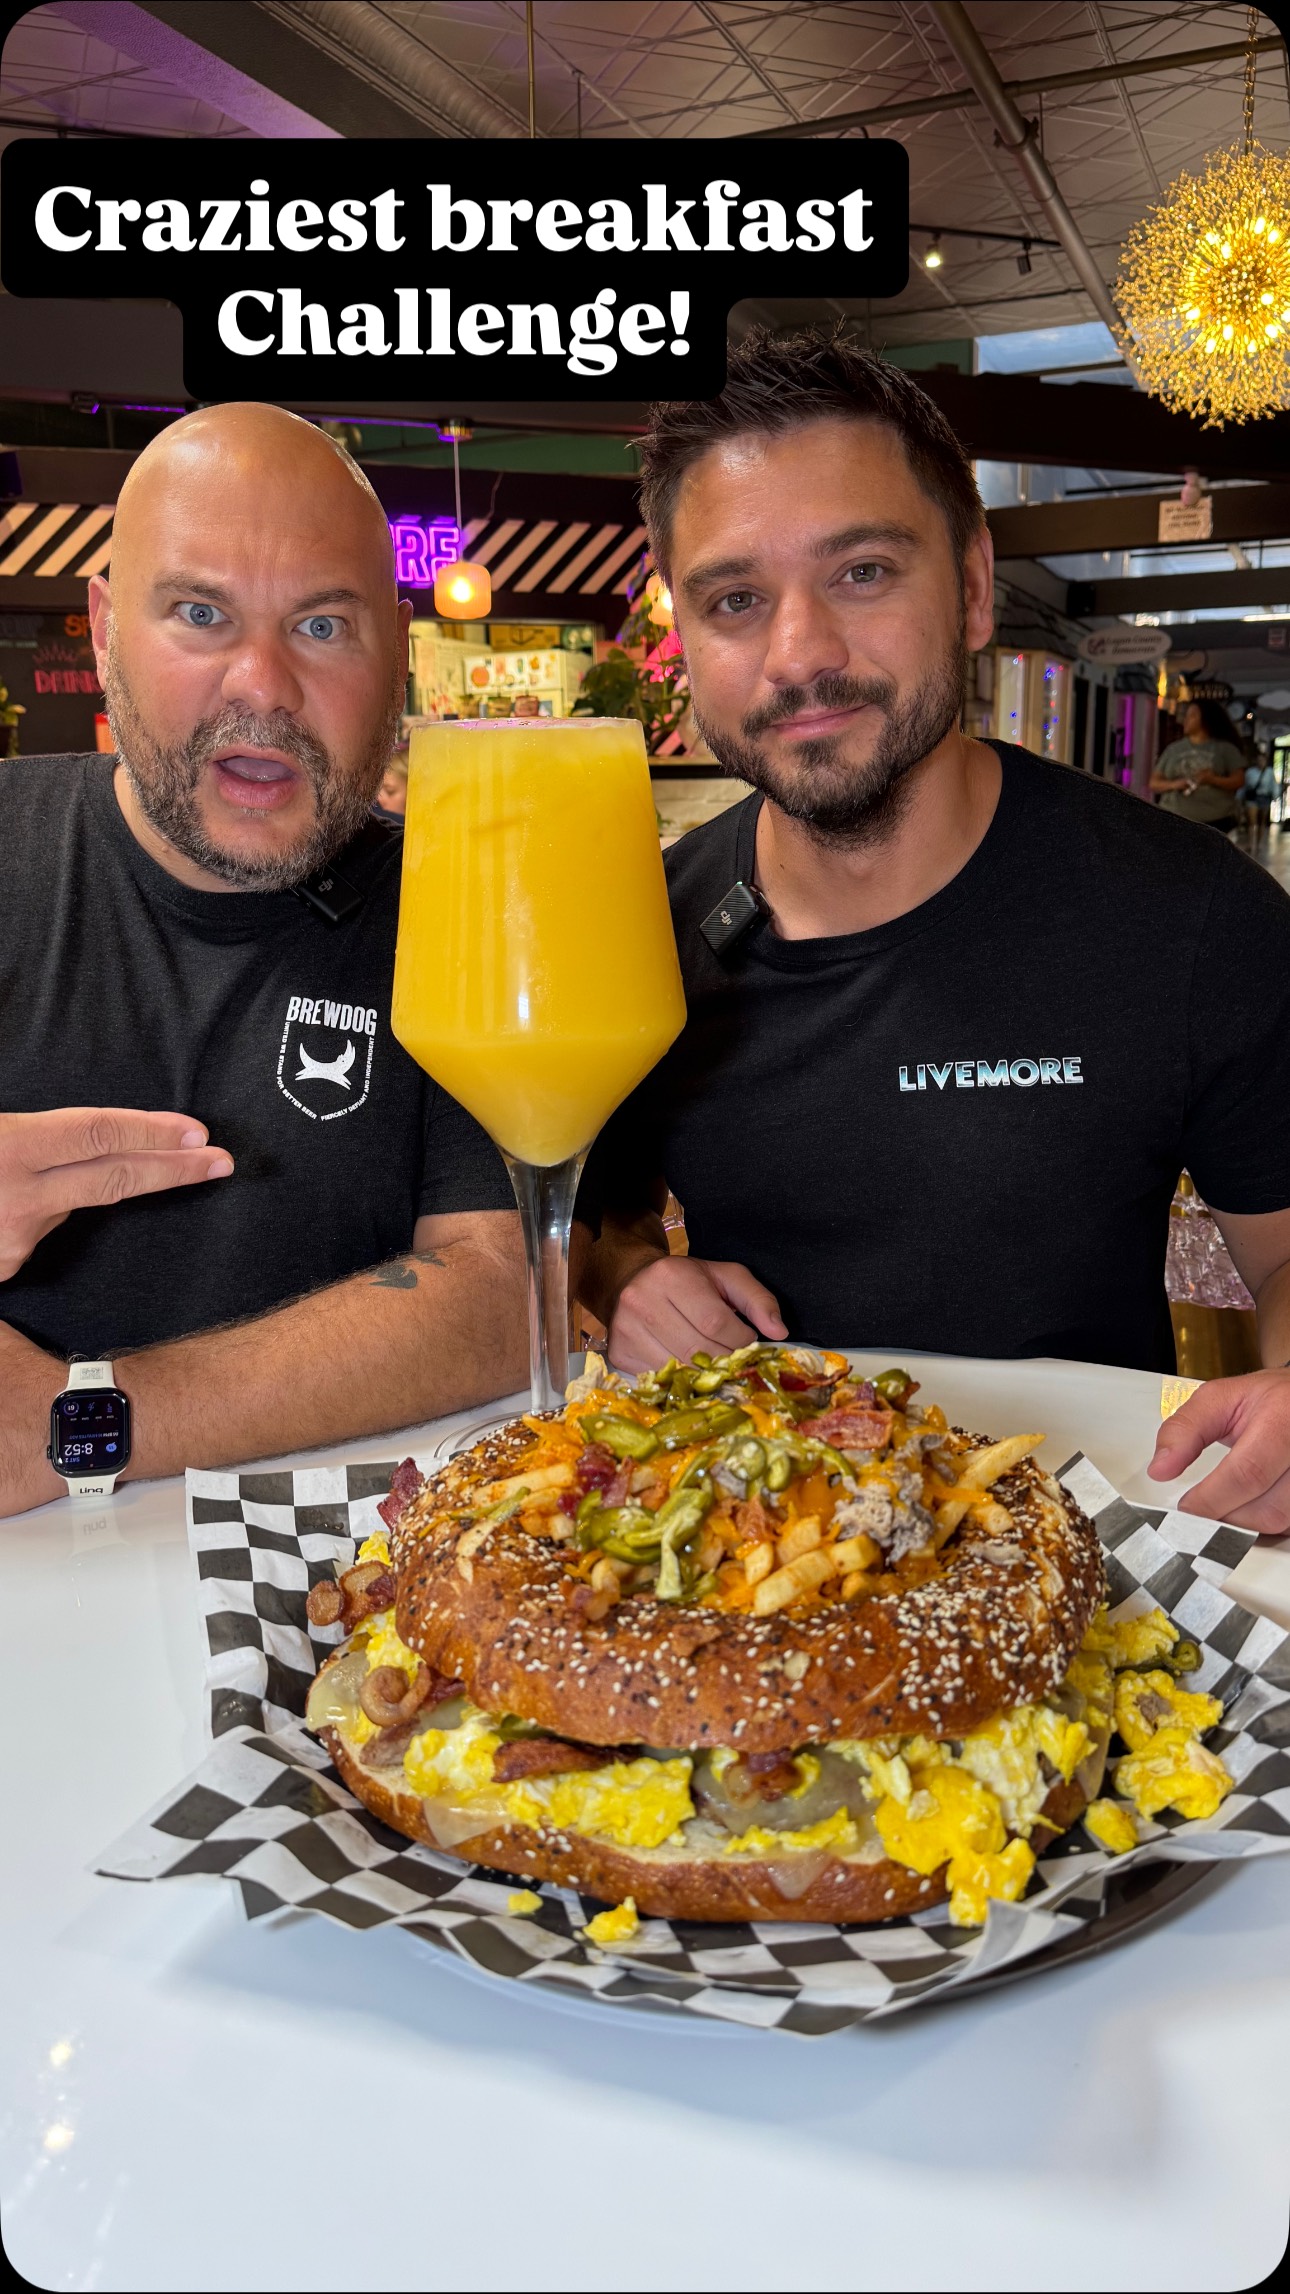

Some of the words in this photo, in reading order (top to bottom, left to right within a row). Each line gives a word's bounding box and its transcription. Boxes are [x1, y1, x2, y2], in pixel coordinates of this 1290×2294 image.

[389, 526, 460, 584] RE
[286, 996, 378, 1036] BREWDOG
[320, 1107, 348, 1122] FIERCELY
[348, 1092, 368, 1112] DEFIANT
[365, 1036, 375, 1079] INDEPENDENT
[899, 1057, 1084, 1091] LIVEMORE
[282, 1088, 303, 1109] BETTER
[301, 1105, 318, 1120] BEER
[64, 1442, 93, 1456] 8:52
